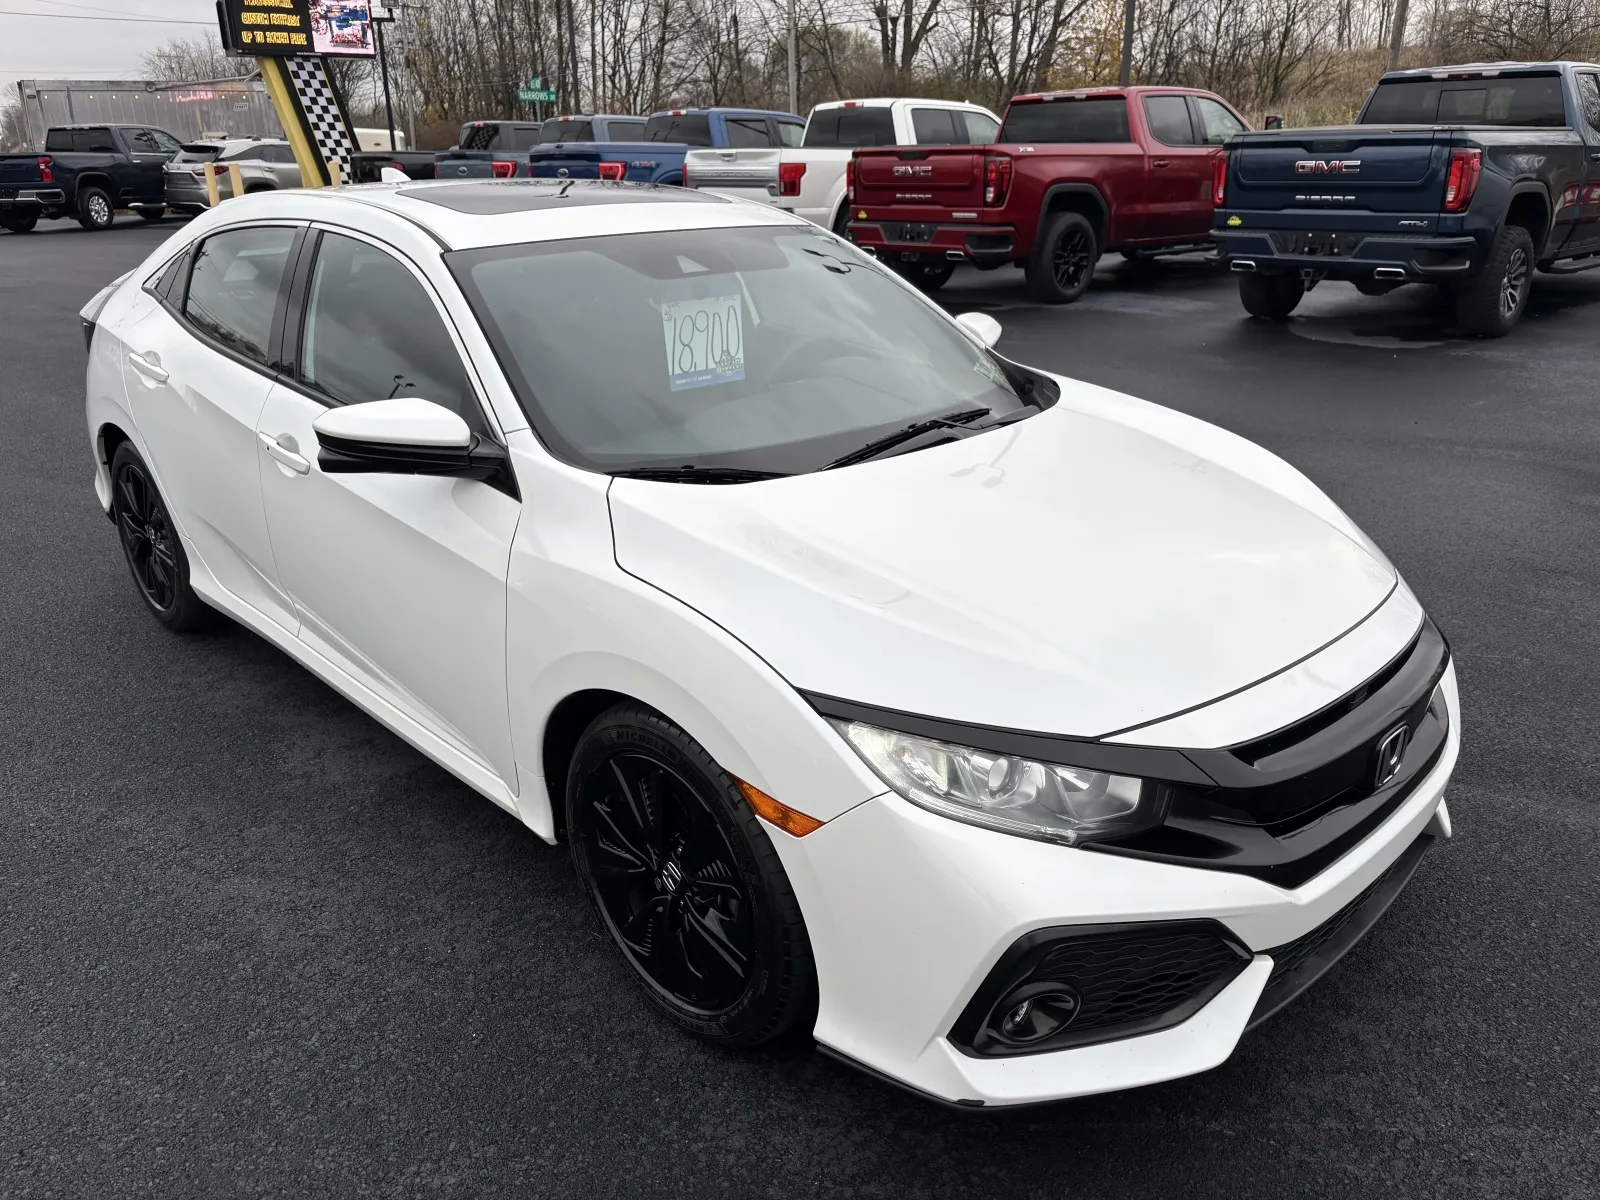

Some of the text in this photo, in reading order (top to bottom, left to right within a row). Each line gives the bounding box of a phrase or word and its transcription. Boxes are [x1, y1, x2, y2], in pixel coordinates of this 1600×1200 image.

[241, 31, 253, 43] UP
[254, 31, 265, 43] TO
[290, 32, 308, 45] PIPE
[892, 165, 933, 177] GMC
[1295, 160, 1361, 174] GMC
[1295, 194, 1356, 202] SIERRA
